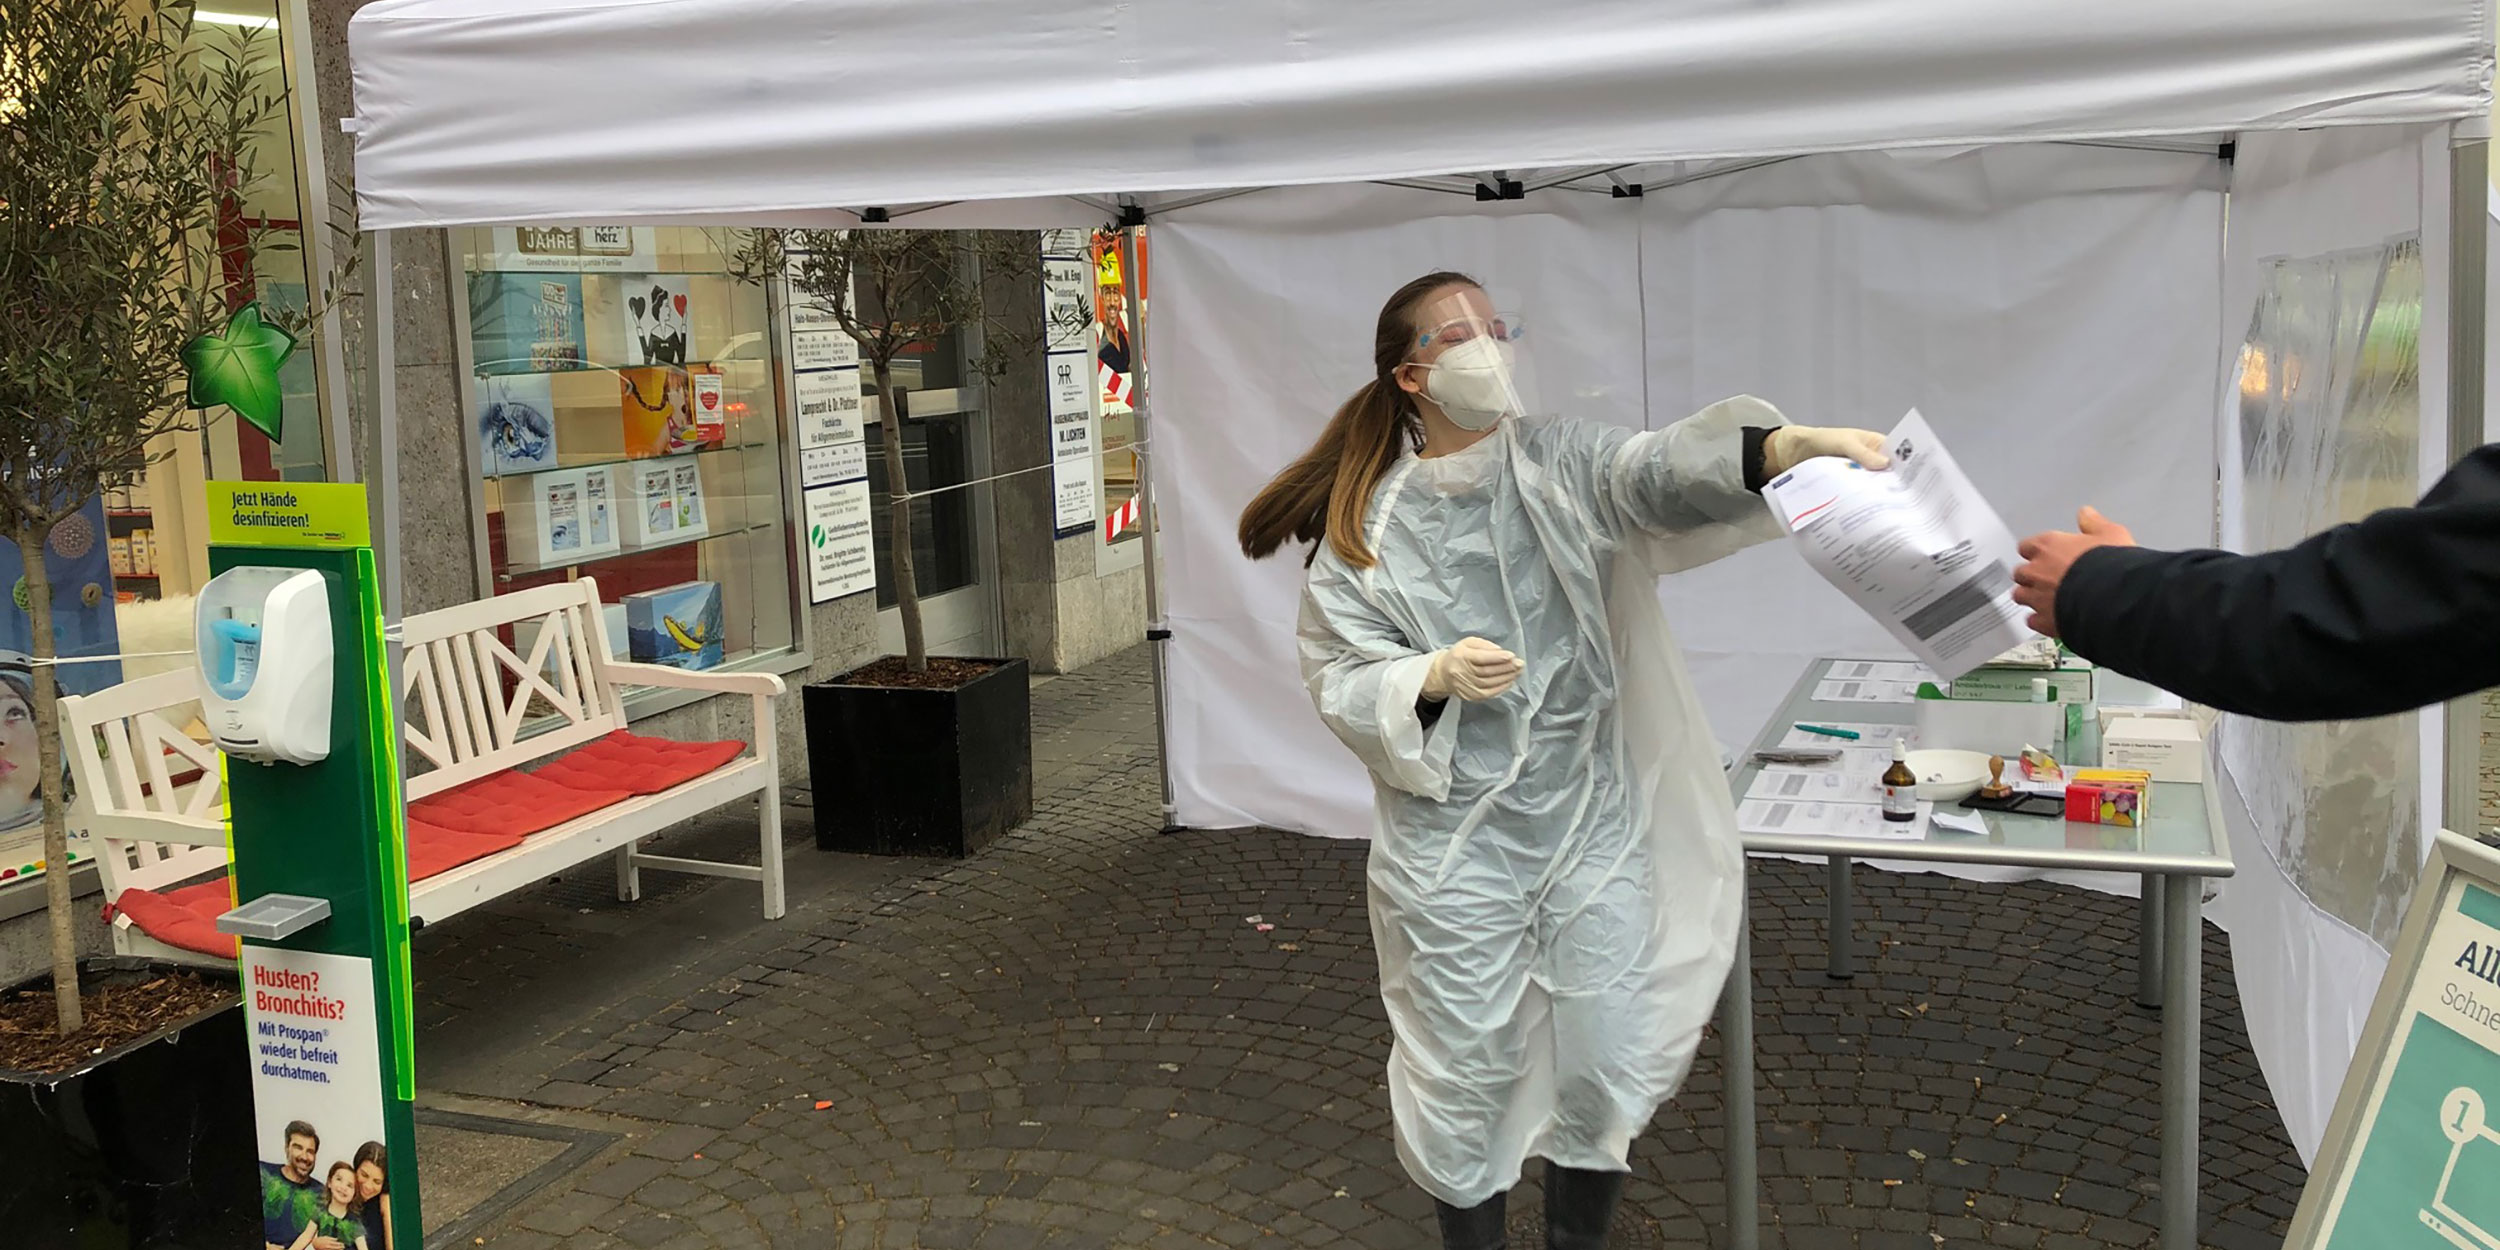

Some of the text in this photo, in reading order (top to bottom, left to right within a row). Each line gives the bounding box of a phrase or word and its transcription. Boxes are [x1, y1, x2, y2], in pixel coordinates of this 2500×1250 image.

[526, 233, 575, 250] JAHRE
[594, 229, 618, 243] herz
[232, 491, 298, 509] Jetzt Hände
[232, 510, 310, 528] desinfizieren!
[2455, 941, 2500, 988] All
[254, 965, 320, 992] Husten?
[256, 991, 345, 1021] Bronchitis?
[258, 1021, 277, 1037] Mit
[259, 1042, 338, 1065] wieder befreit
[261, 1061, 331, 1084] durchatmen.
[2451, 1101, 2470, 1133] 1
